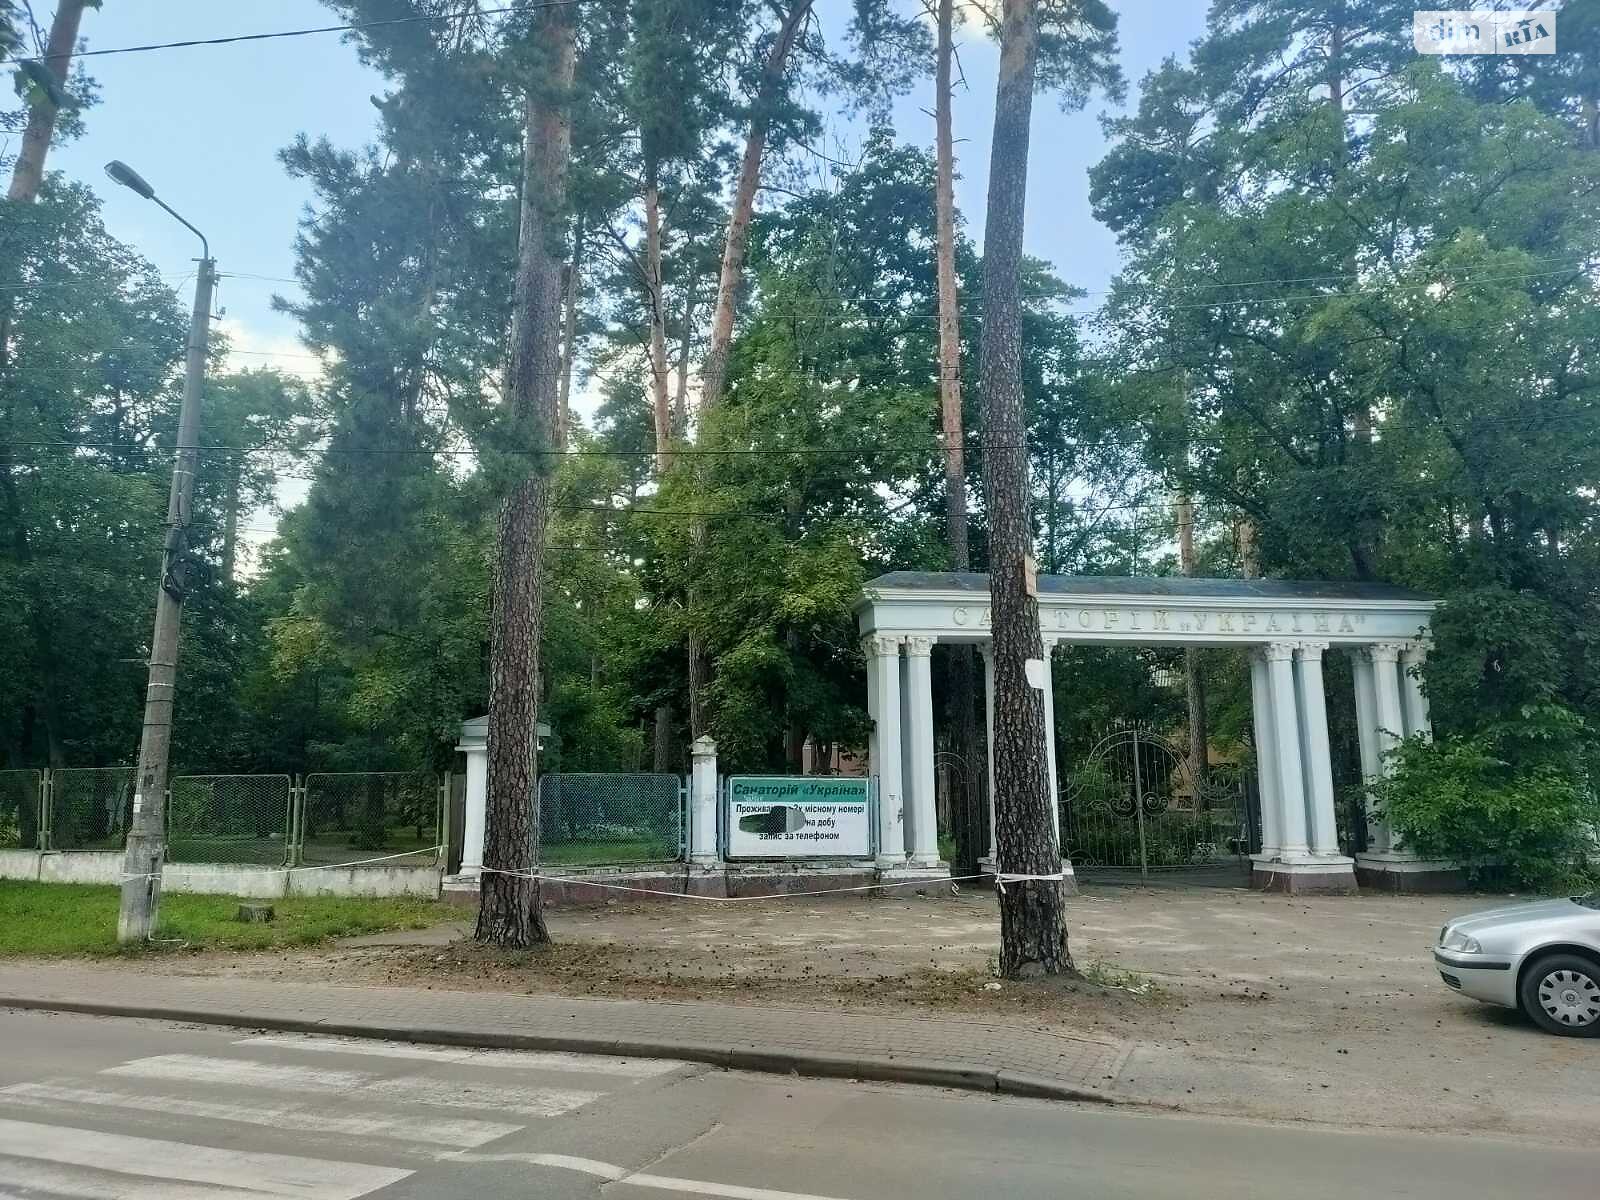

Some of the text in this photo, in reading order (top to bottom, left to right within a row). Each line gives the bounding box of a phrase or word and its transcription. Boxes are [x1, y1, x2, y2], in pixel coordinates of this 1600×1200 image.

[952, 606, 1170, 630] САТОРІЙ
[733, 783, 866, 798] Санаторій «Україна»
[805, 804, 837, 814] місному
[838, 805, 865, 814] номері
[817, 817, 836, 828] добу
[759, 832, 782, 840] запис
[796, 831, 840, 842] телефоном
